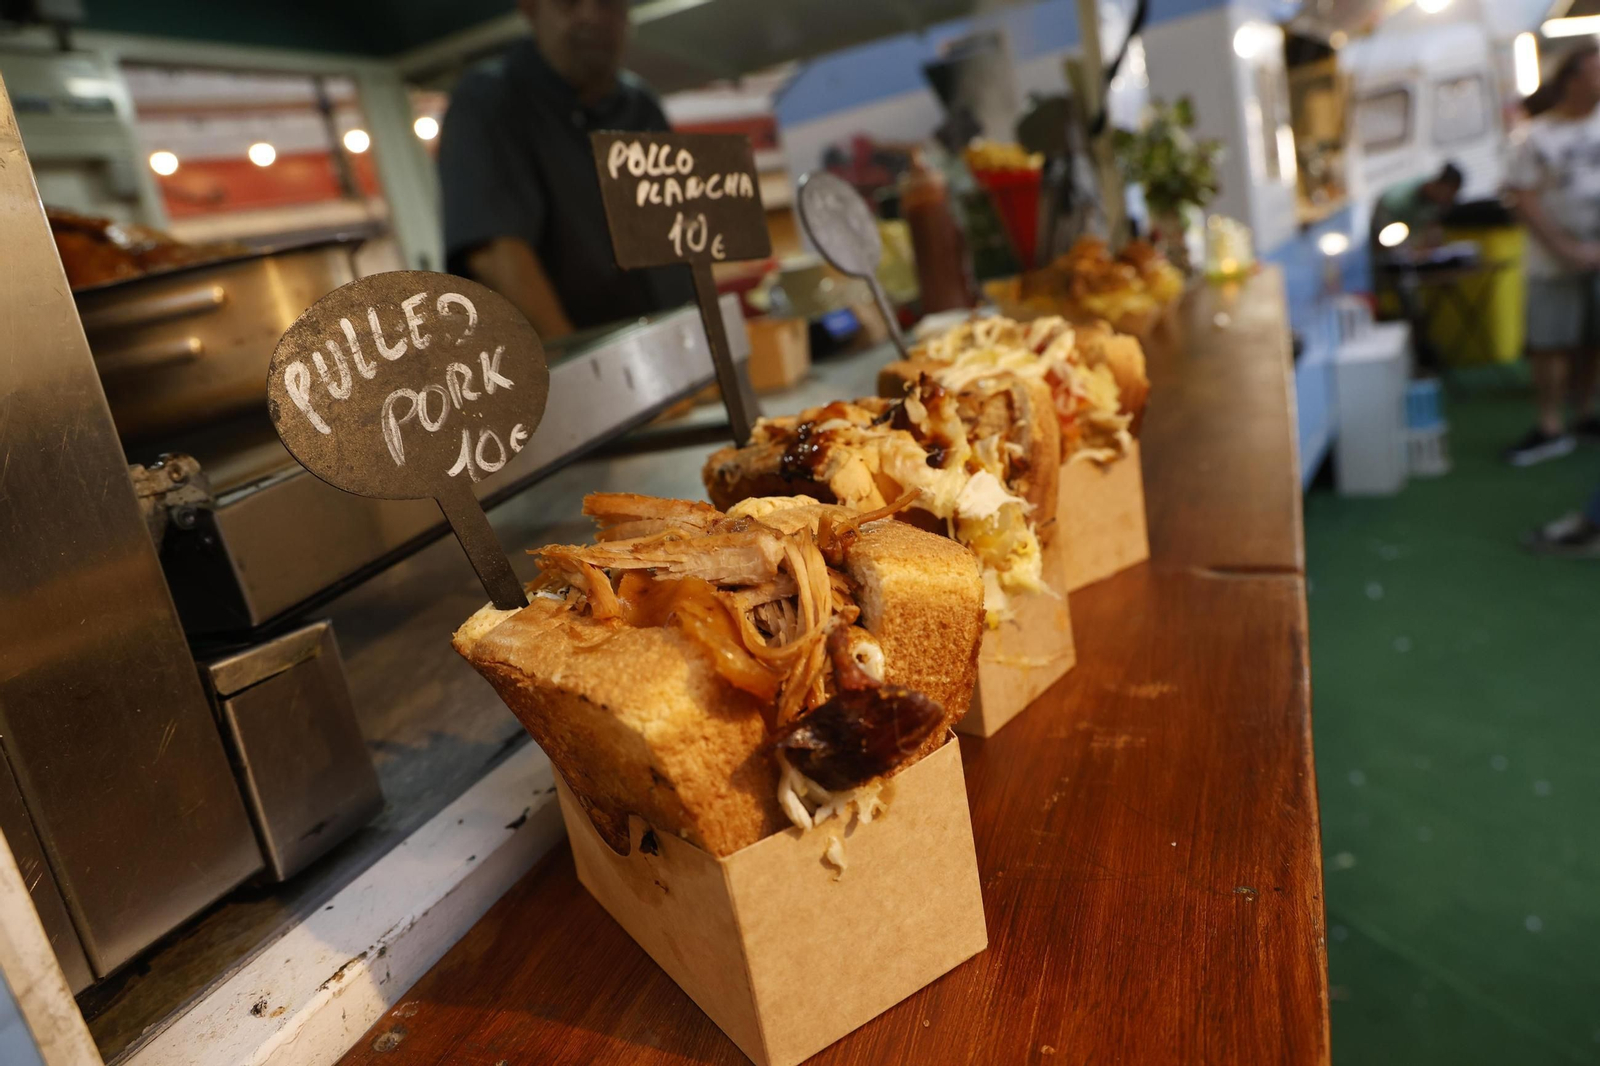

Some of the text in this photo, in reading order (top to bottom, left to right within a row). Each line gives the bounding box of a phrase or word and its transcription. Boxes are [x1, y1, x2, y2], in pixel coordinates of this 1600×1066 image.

[607, 139, 694, 180] POLLO
[636, 172, 754, 207] PLANCHA
[284, 292, 478, 434] PULLED
[381, 346, 515, 467] PORK
[446, 423, 529, 483] 10€
